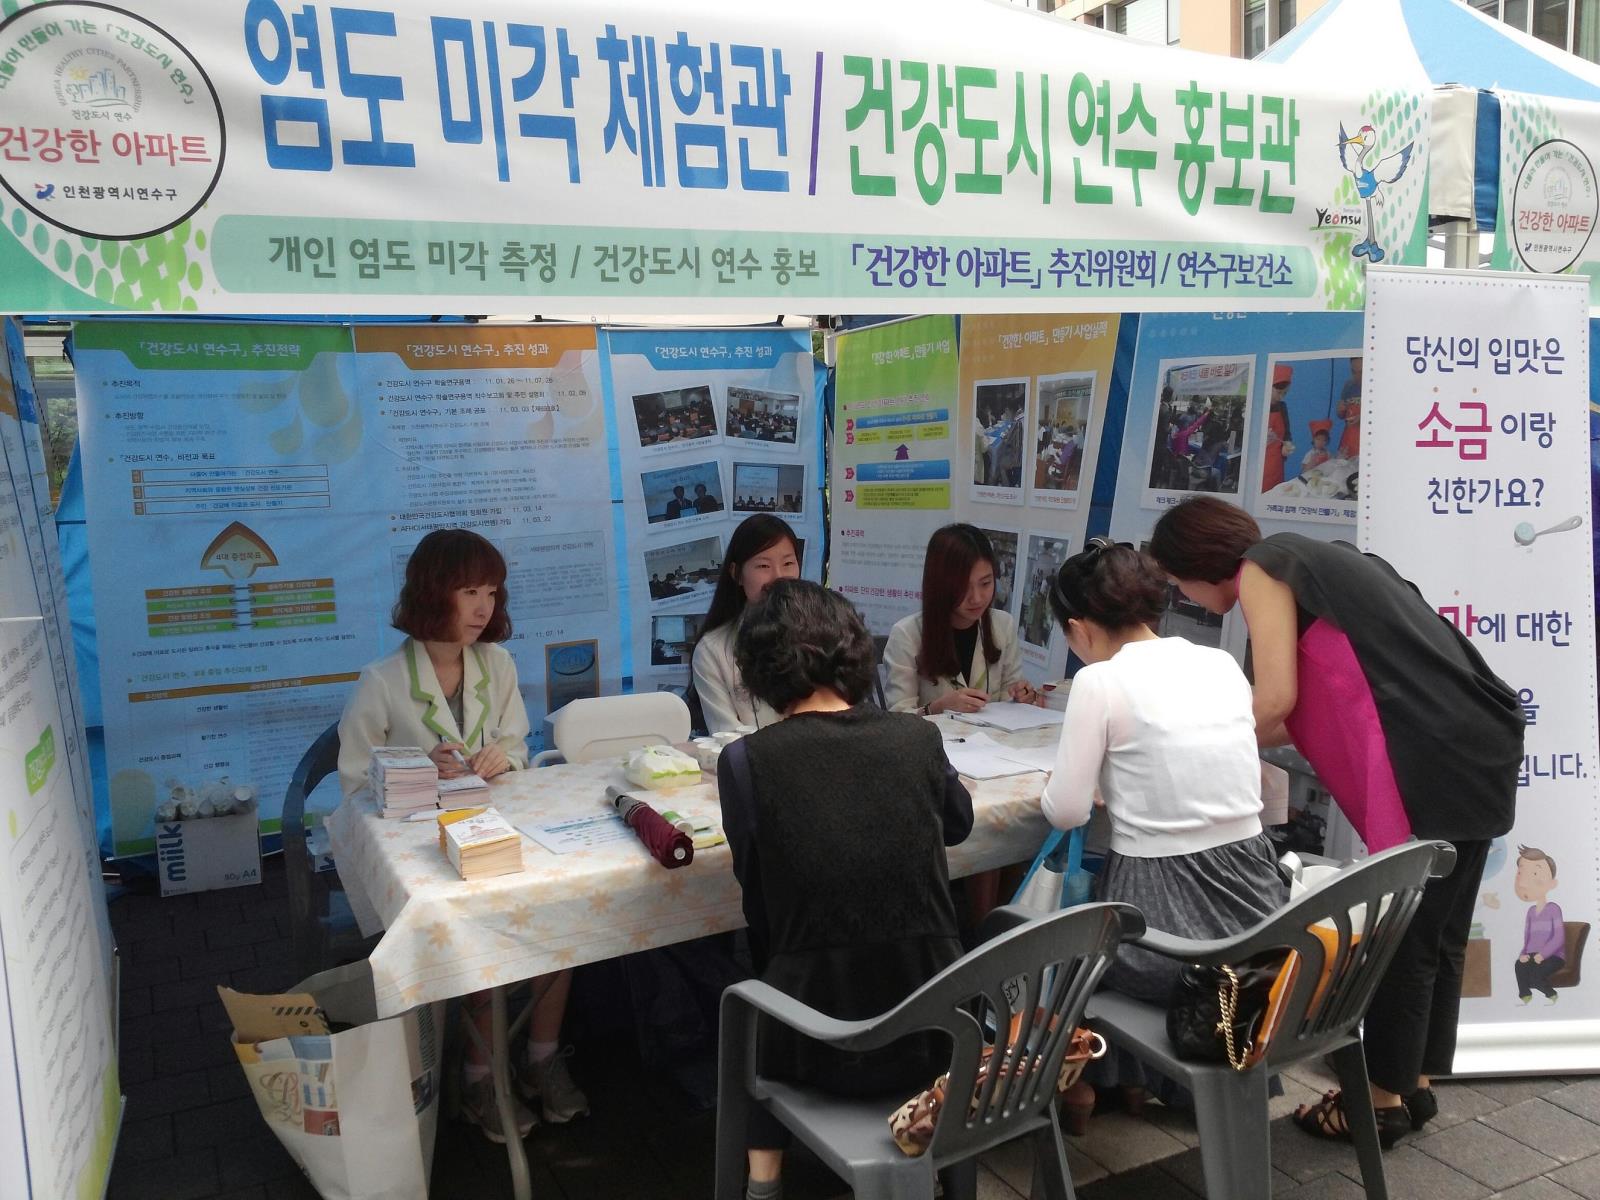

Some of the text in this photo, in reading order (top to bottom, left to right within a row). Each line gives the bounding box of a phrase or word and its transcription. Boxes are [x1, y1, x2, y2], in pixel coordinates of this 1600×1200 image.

[64, 19, 97, 35] 가는
[244, 0, 416, 172] 염도
[430, 16, 581, 184] 미각
[597, 24, 792, 193] 체험관
[843, 54, 1051, 206] 건강도시
[1066, 71, 1157, 207] 연수
[1174, 80, 1300, 216] 홍보관
[0, 128, 212, 167] 건강한 아파트
[63, 185, 178, 201] 인천광역시연수구
[1315, 207, 1361, 228] Yeonsu
[1519, 210, 1591, 234] 건강한 아파트
[268, 236, 336, 280] 개인
[350, 240, 415, 280] 염도
[428, 240, 489, 281] 미각
[499, 243, 557, 284] 측정
[593, 245, 701, 284] 건강도시
[711, 248, 763, 284] 연수
[771, 249, 820, 285] 홍보
[852, 243, 950, 289] 「건강한
[956, 248, 1042, 290] 아파트」
[1047, 247, 1157, 289] 추진위원회
[1177, 252, 1294, 289] 연수구보건소
[139, 341, 300, 358] 「건강도시 연수구」 추진전략
[406, 343, 550, 358] 「건강도시 연수구」 추진 성과
[655, 345, 773, 359] 「건강도시 연수구」 추진 성과
[937, 338, 950, 353] 사업
[1406, 336, 1565, 375] 당신의 입맛은
[1428, 477, 1545, 514] 친한가요?
[1516, 610, 1573, 647] 대한
[242, 868, 257, 879] A4
